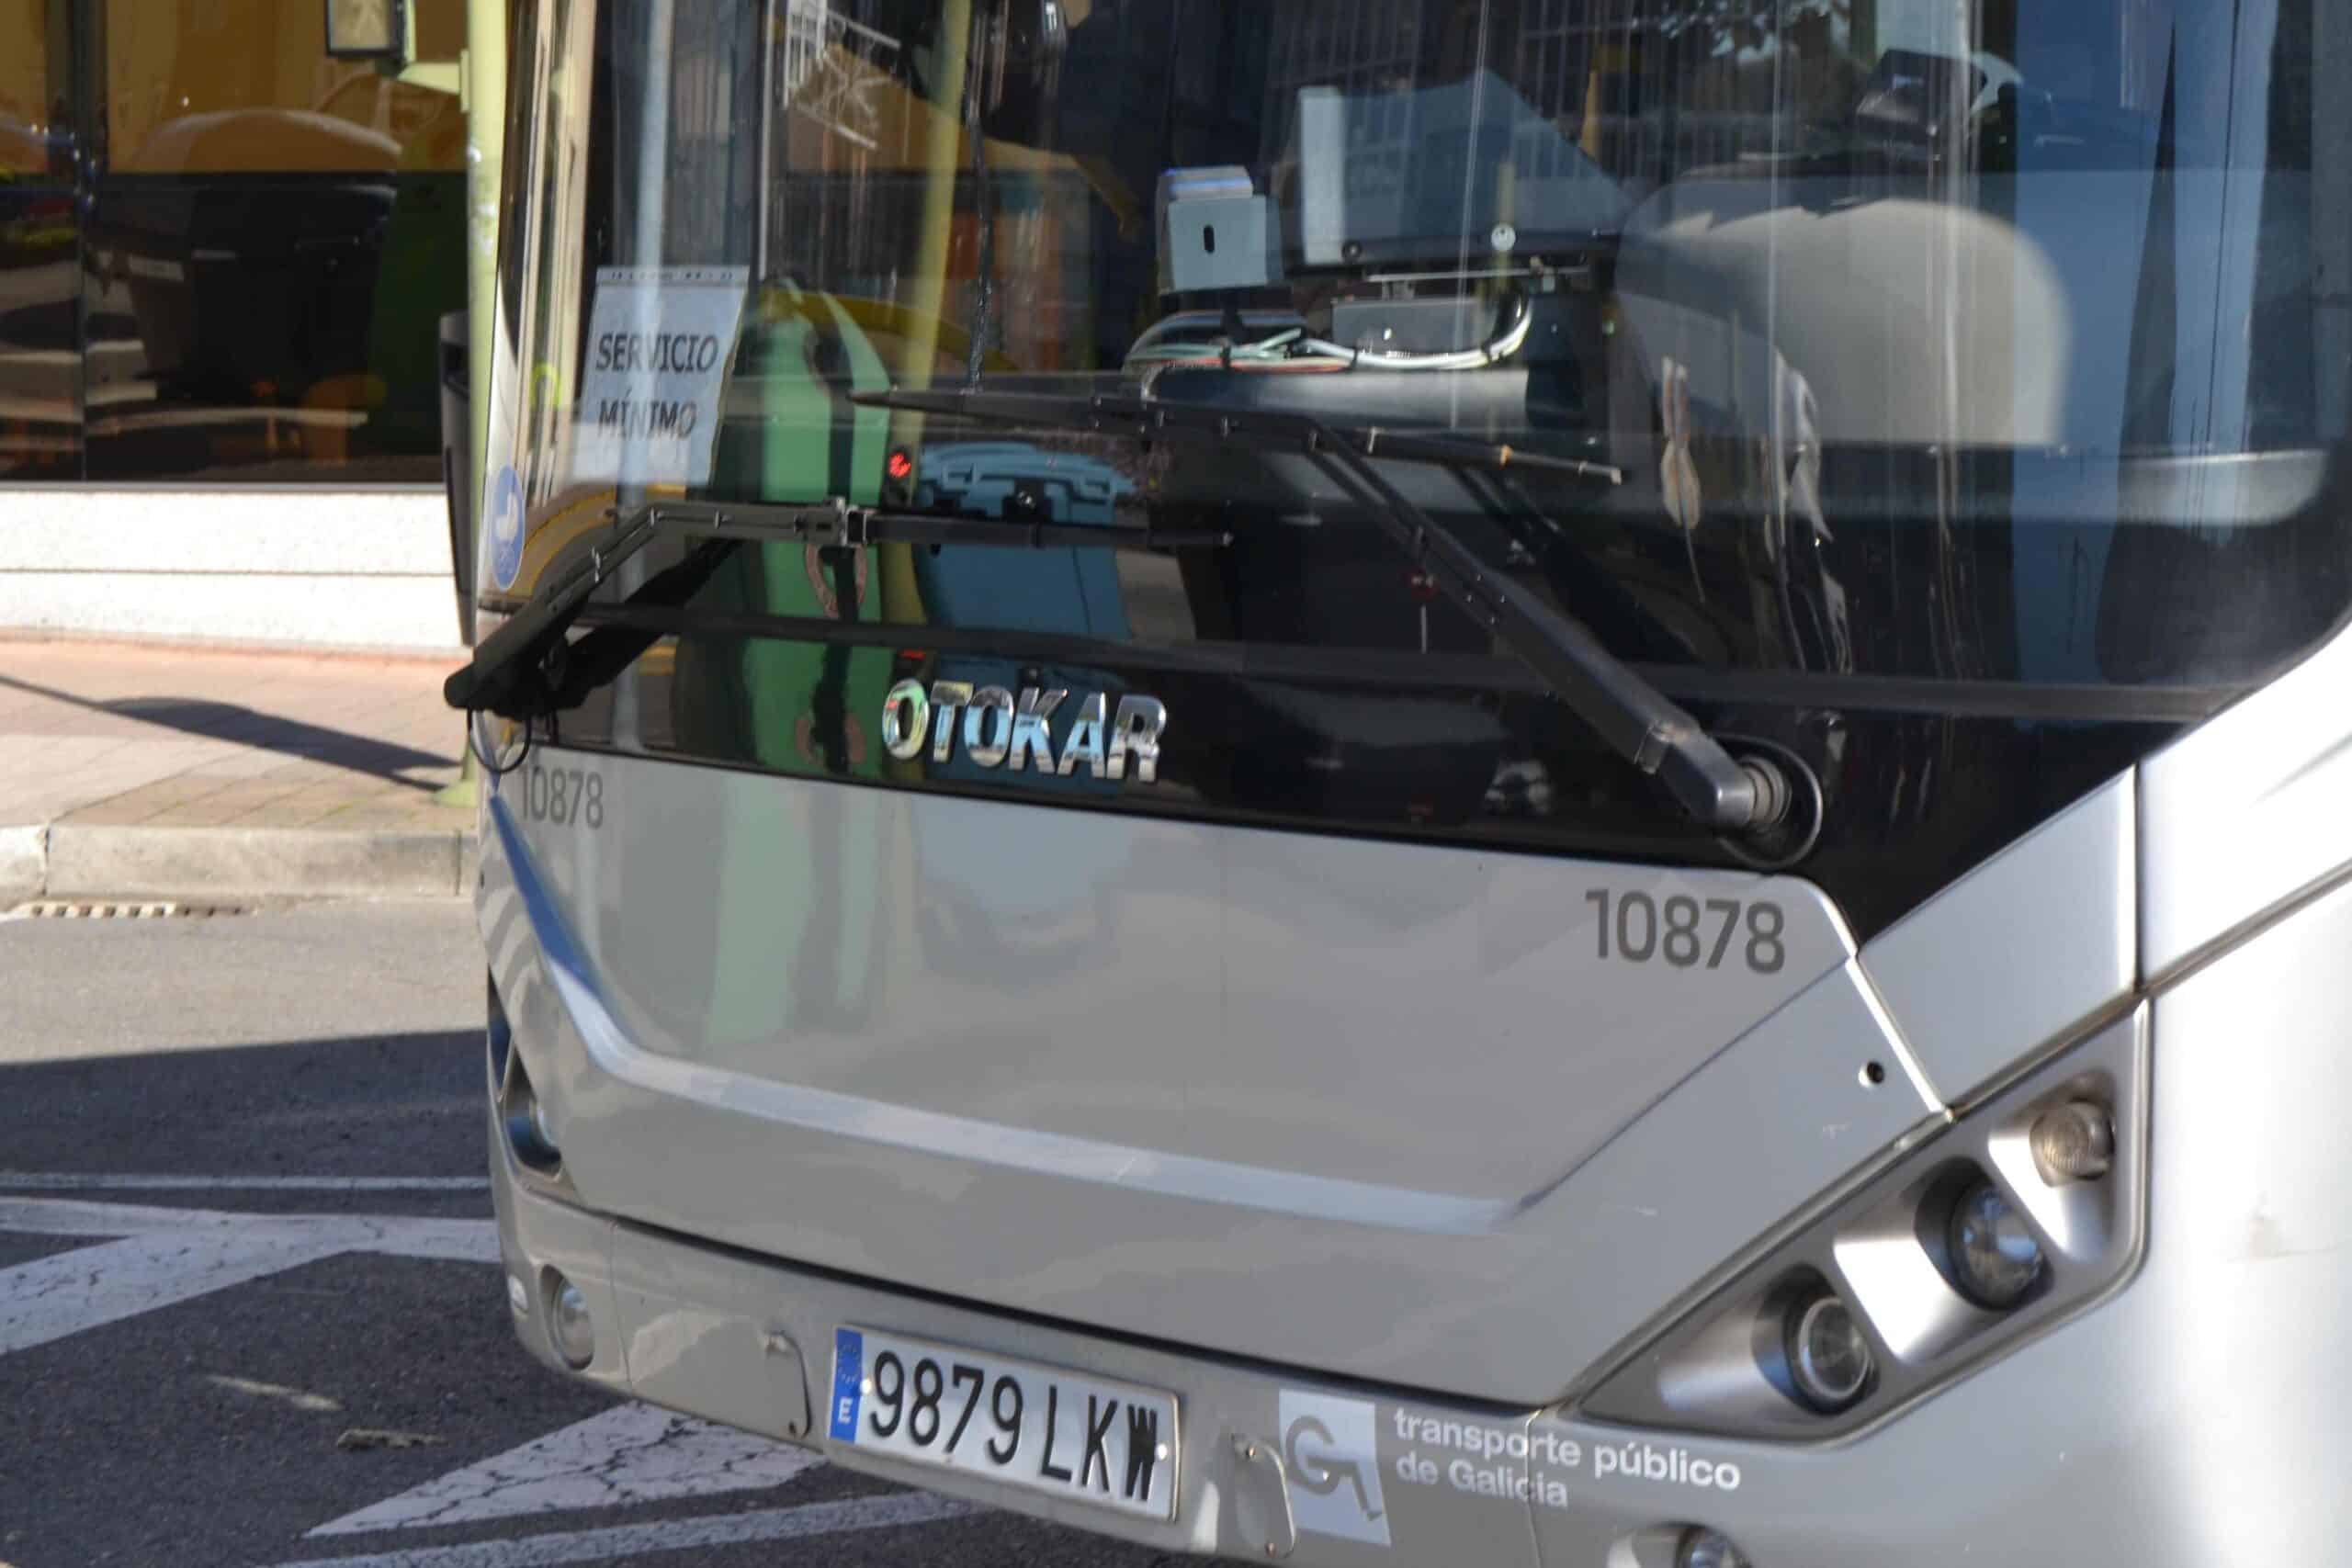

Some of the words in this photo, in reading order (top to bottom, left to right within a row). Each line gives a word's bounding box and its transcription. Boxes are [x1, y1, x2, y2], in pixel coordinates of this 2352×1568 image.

[595, 332, 718, 374] SERVICIO
[882, 678, 1168, 783] OTOKAR
[518, 762, 605, 830] 10878
[1584, 887, 1786, 975] 10878
[836, 1396, 853, 1425] E
[868, 1349, 1024, 1466] 9879
[1040, 1384, 1159, 1502] LKW
[1394, 1407, 1582, 1467] transporte
[1595, 1441, 1742, 1493] público
[1396, 1451, 1439, 1484] de
[1449, 1459, 1569, 1508] Galicia
